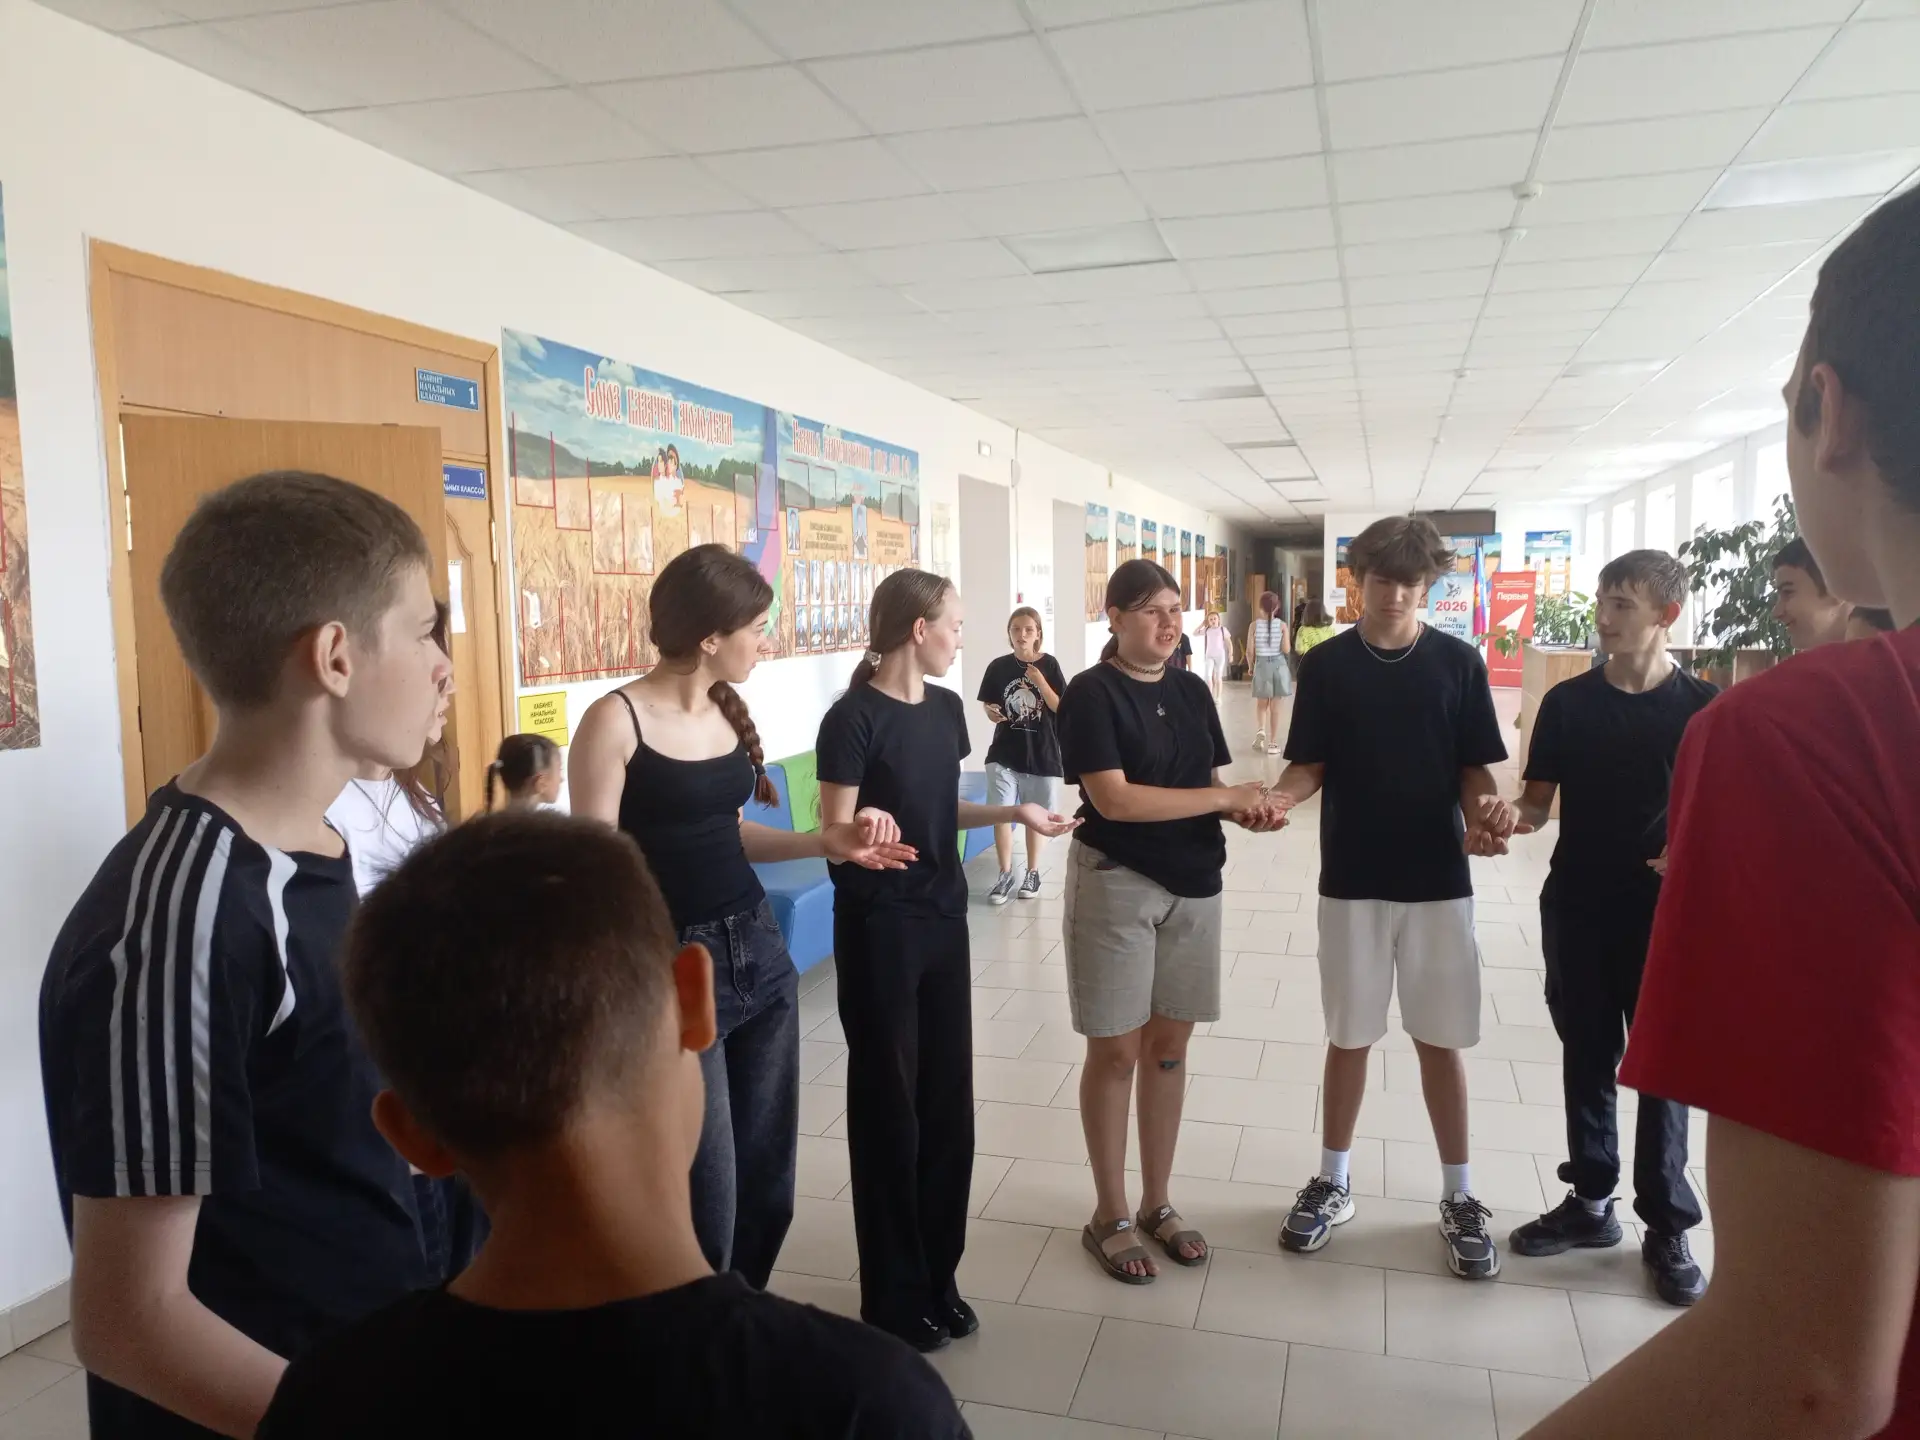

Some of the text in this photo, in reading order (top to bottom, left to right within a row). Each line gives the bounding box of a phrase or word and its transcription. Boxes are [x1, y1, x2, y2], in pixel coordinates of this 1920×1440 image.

[419, 373, 443, 384] КАБИНЕТ
[420, 381, 456, 397] НАЧАЛЬНЫХ
[420, 391, 446, 403] КЛАССОВ
[468, 386, 476, 405] 1
[460, 485, 485, 495] КЛАССОВ
[1497, 591, 1529, 603] Первые
[1435, 601, 1467, 611] 2026
[531, 709, 556, 717] НАЧАЛЬНЫХ
